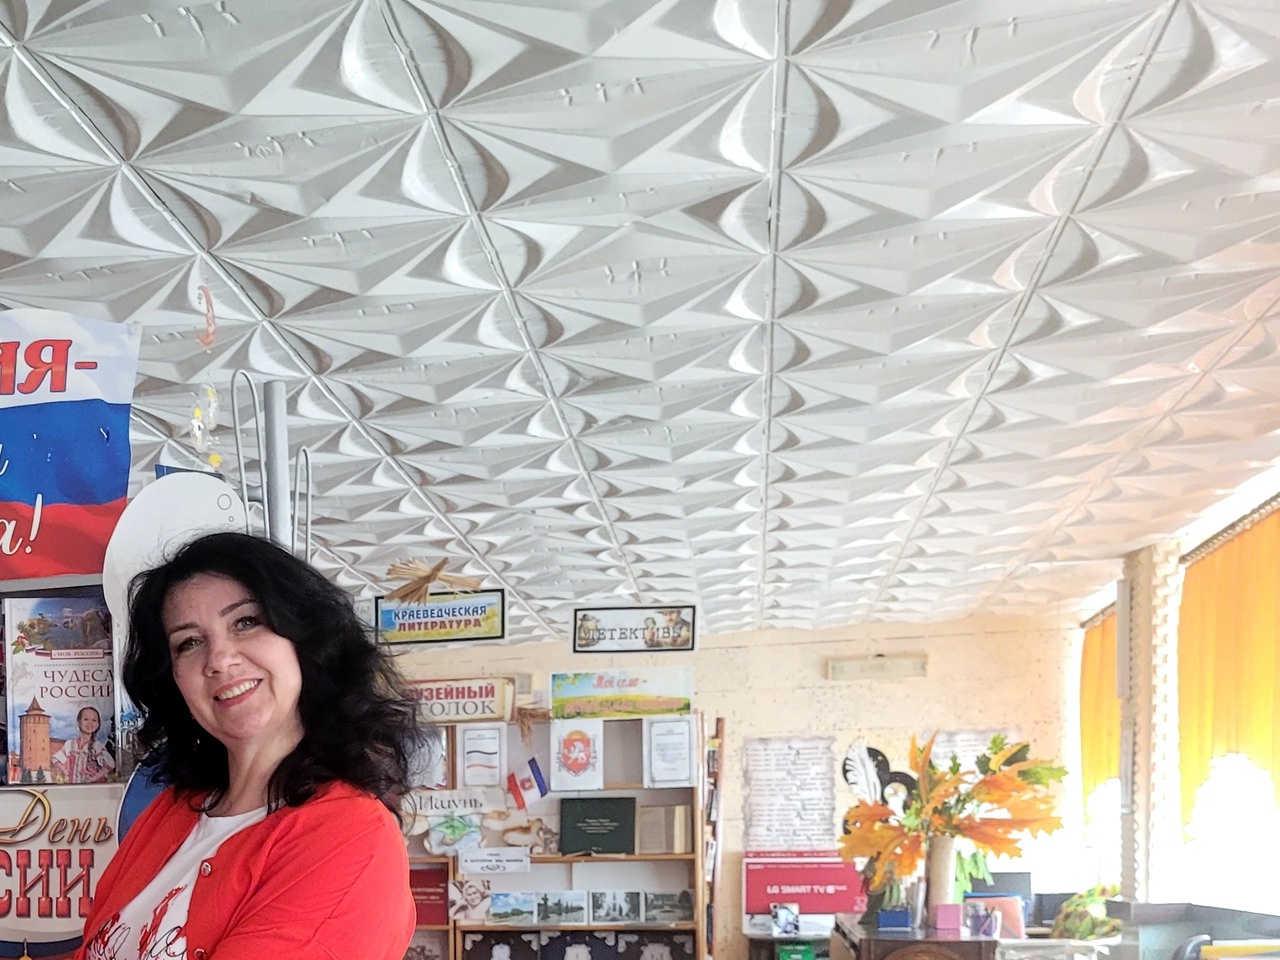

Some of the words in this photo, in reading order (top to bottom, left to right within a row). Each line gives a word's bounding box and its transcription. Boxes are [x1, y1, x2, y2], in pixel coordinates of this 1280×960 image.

[394, 606, 486, 620] КРАЕВЕДЧЕСКАЯ
[398, 618, 481, 632] ЛИТЕРАТУРА
[43, 669, 114, 683] ЧУДЕСА
